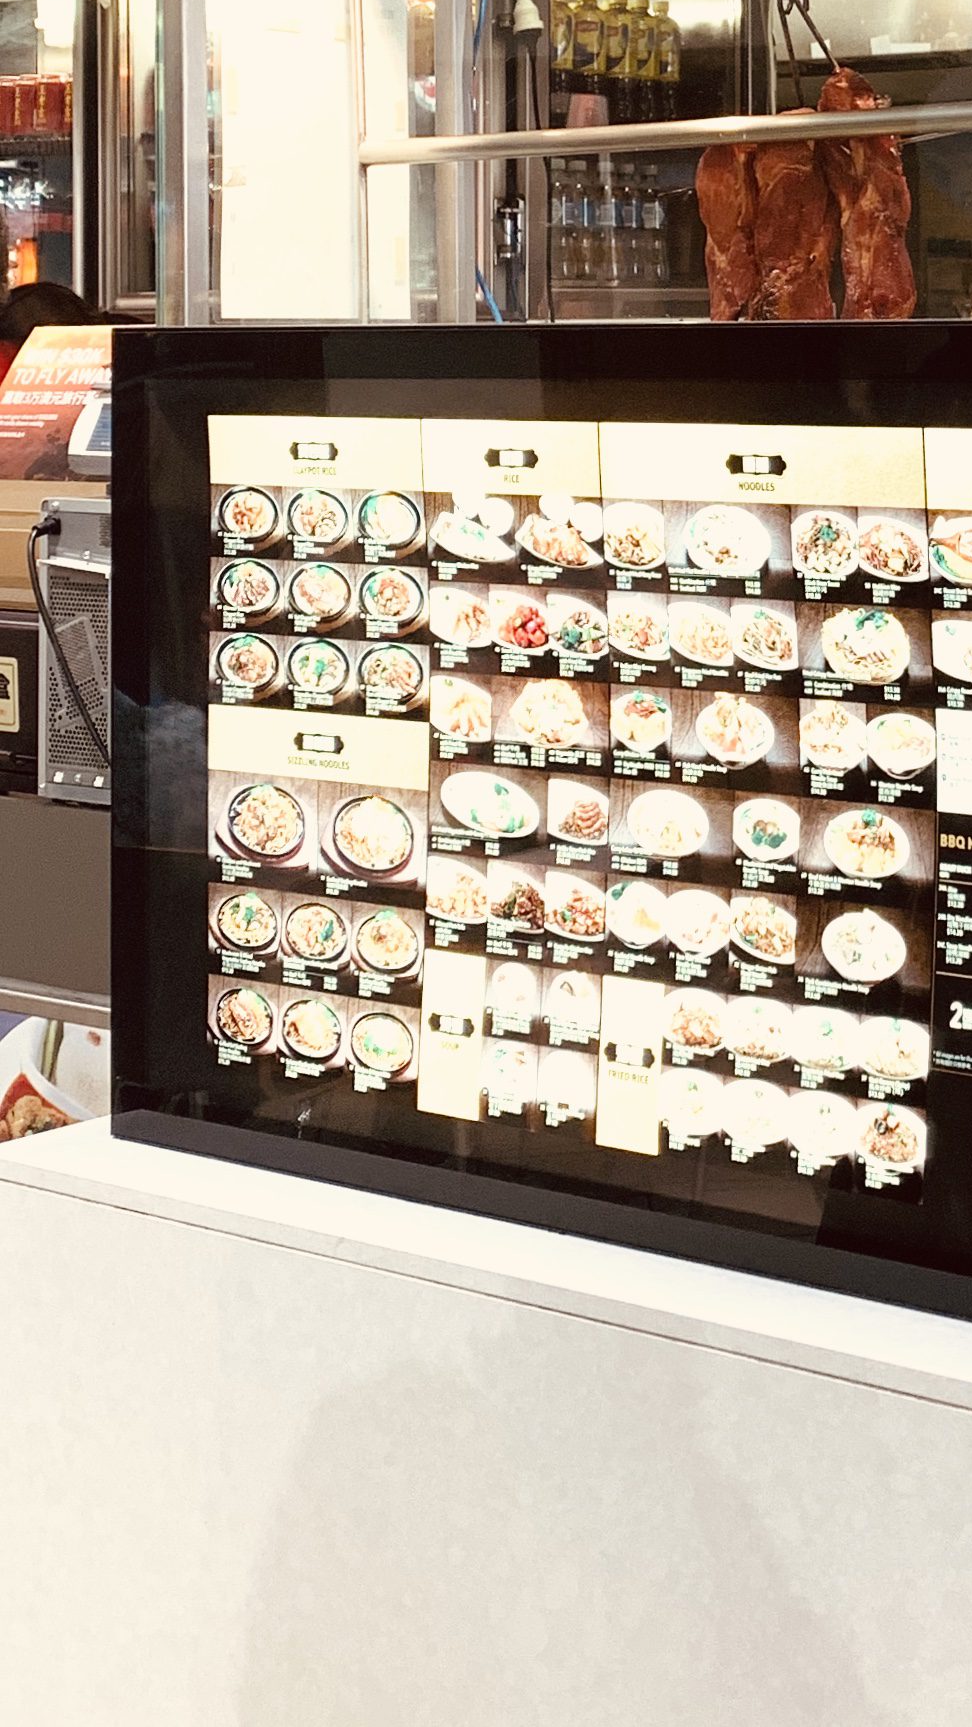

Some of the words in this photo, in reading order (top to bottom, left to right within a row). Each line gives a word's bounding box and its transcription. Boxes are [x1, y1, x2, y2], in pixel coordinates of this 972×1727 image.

[13, 368, 35, 384] TO
[35, 368, 68, 384] FLY
[503, 474, 520, 484] RICE
[738, 481, 776, 492] NOODLES
[940, 833, 966, 849] BBQ
[950, 1001, 963, 1029] 2
[631, 1073, 649, 1084] RICE
